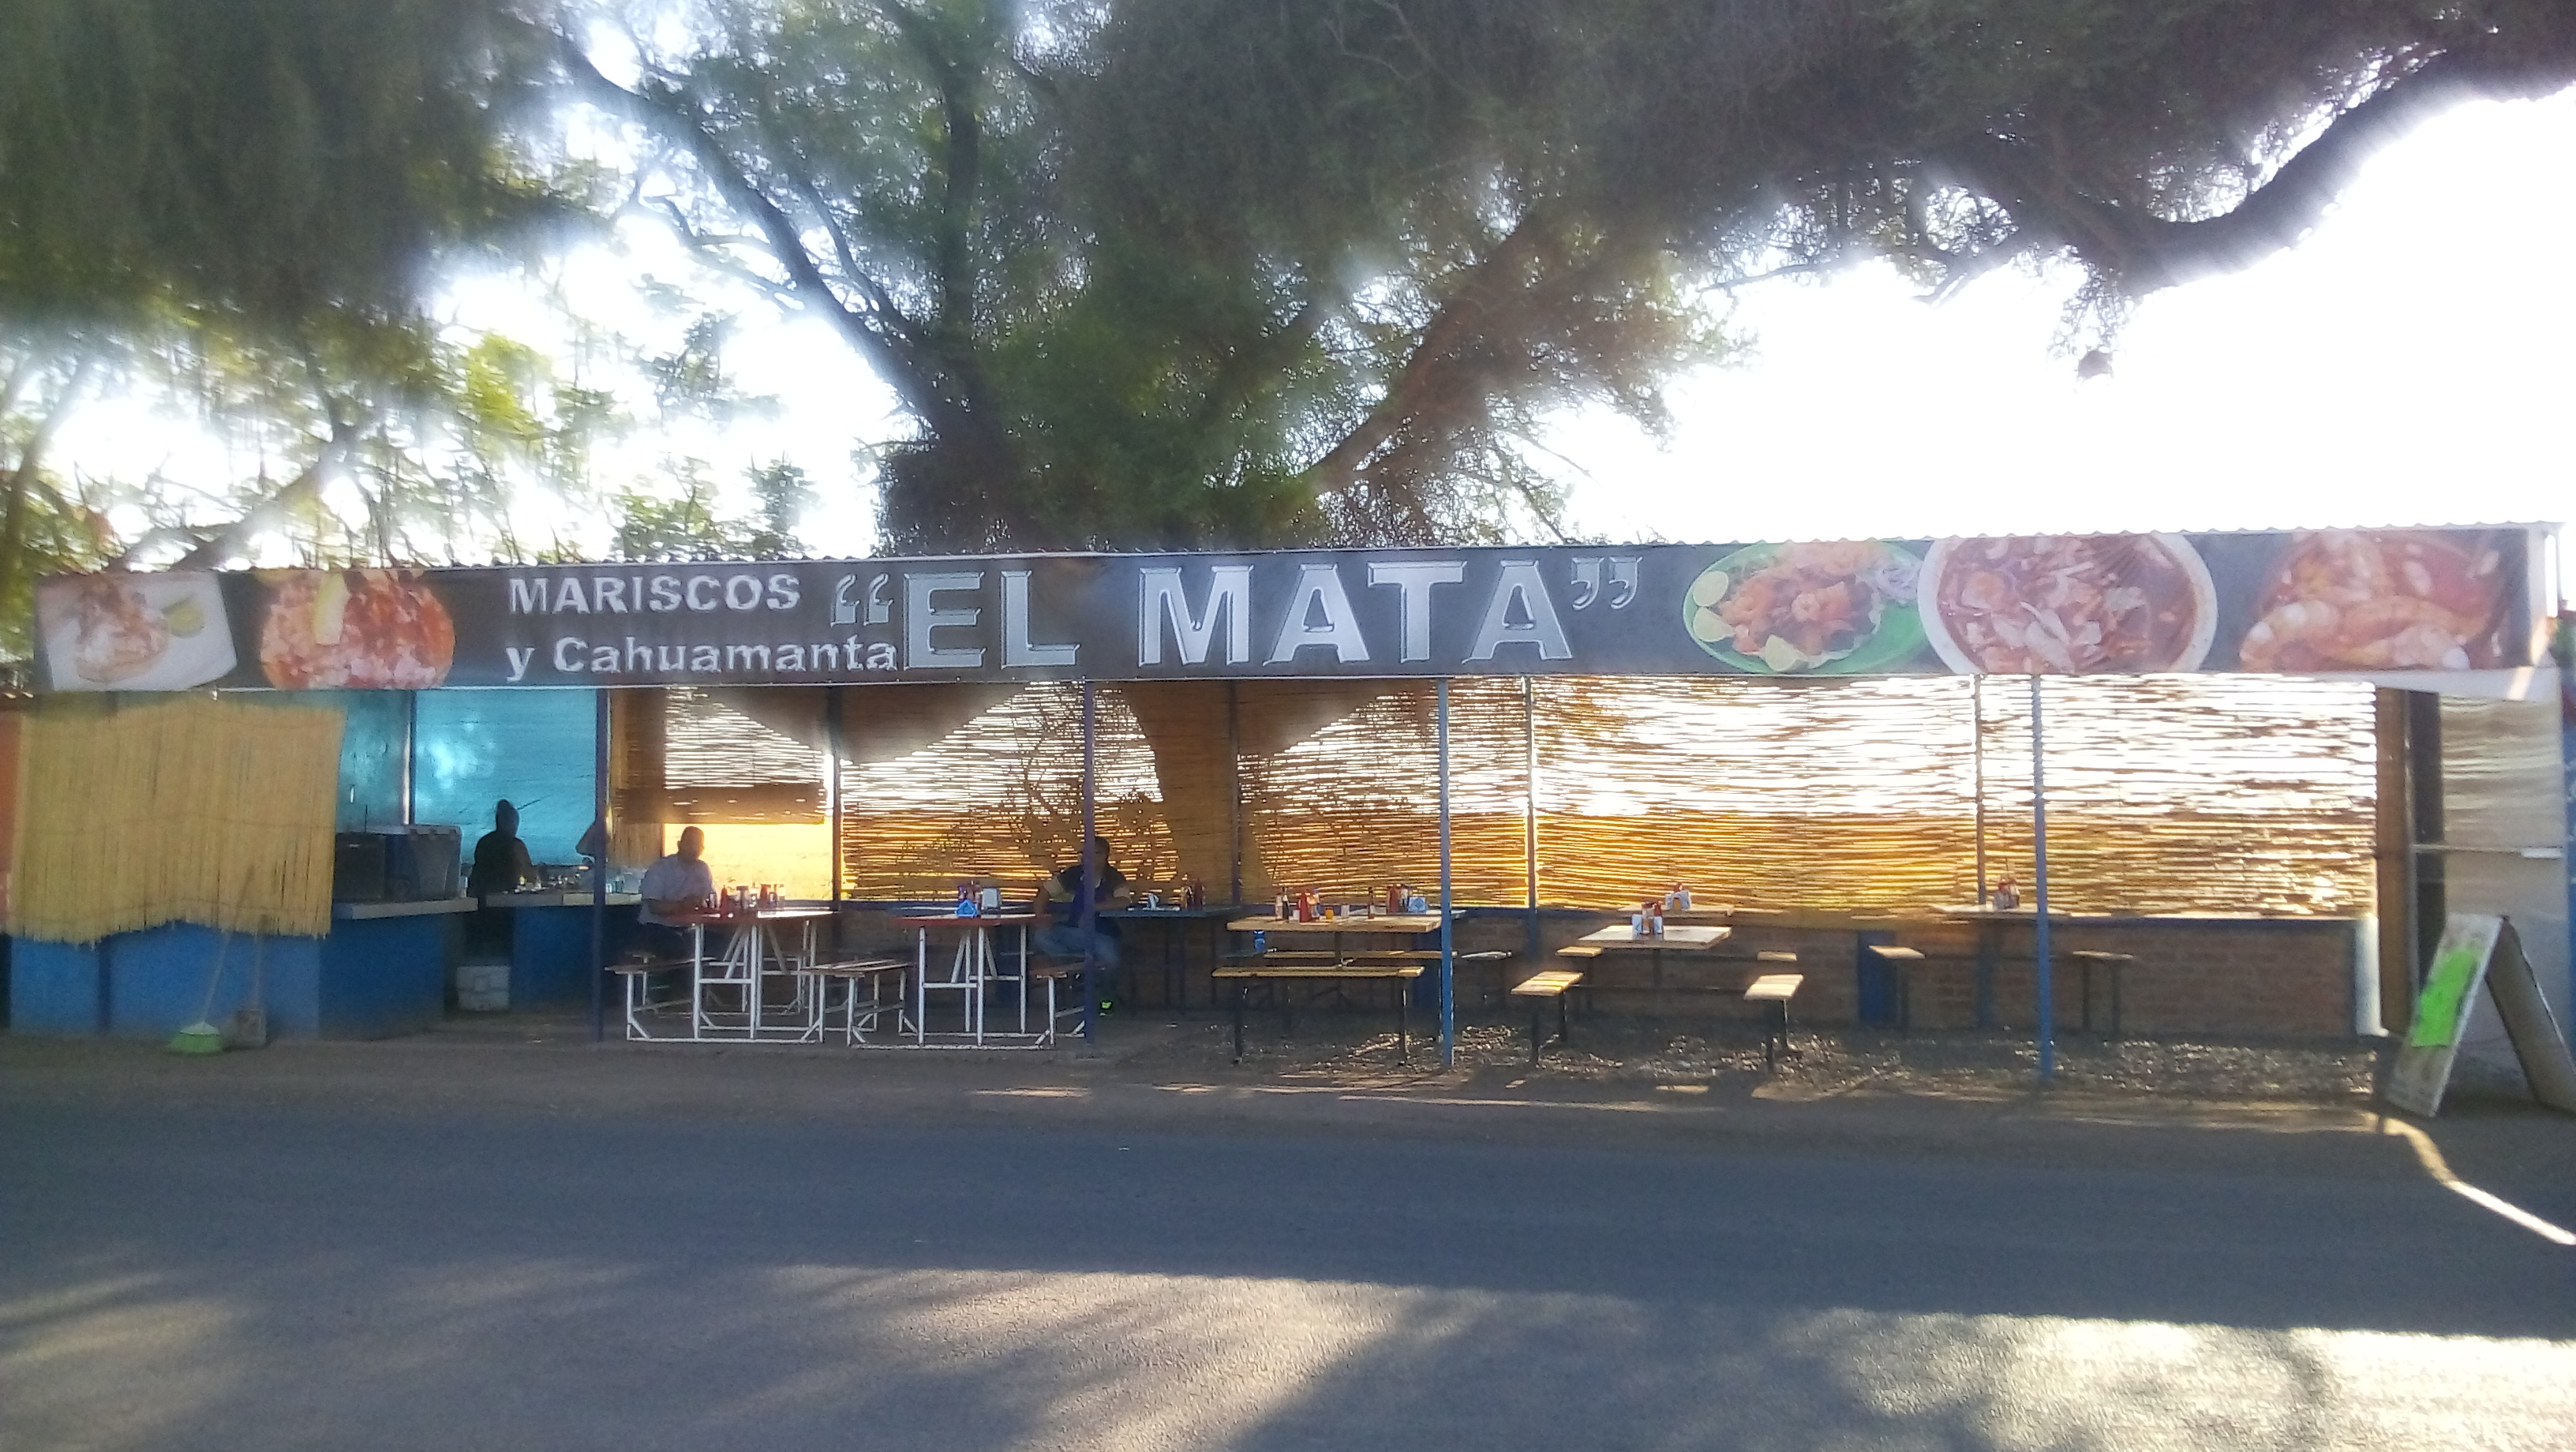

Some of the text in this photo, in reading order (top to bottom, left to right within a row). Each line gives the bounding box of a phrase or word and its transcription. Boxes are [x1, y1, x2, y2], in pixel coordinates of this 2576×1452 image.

[508, 573, 802, 614] MARISCOS
[505, 635, 897, 682] y Cahuamanta
